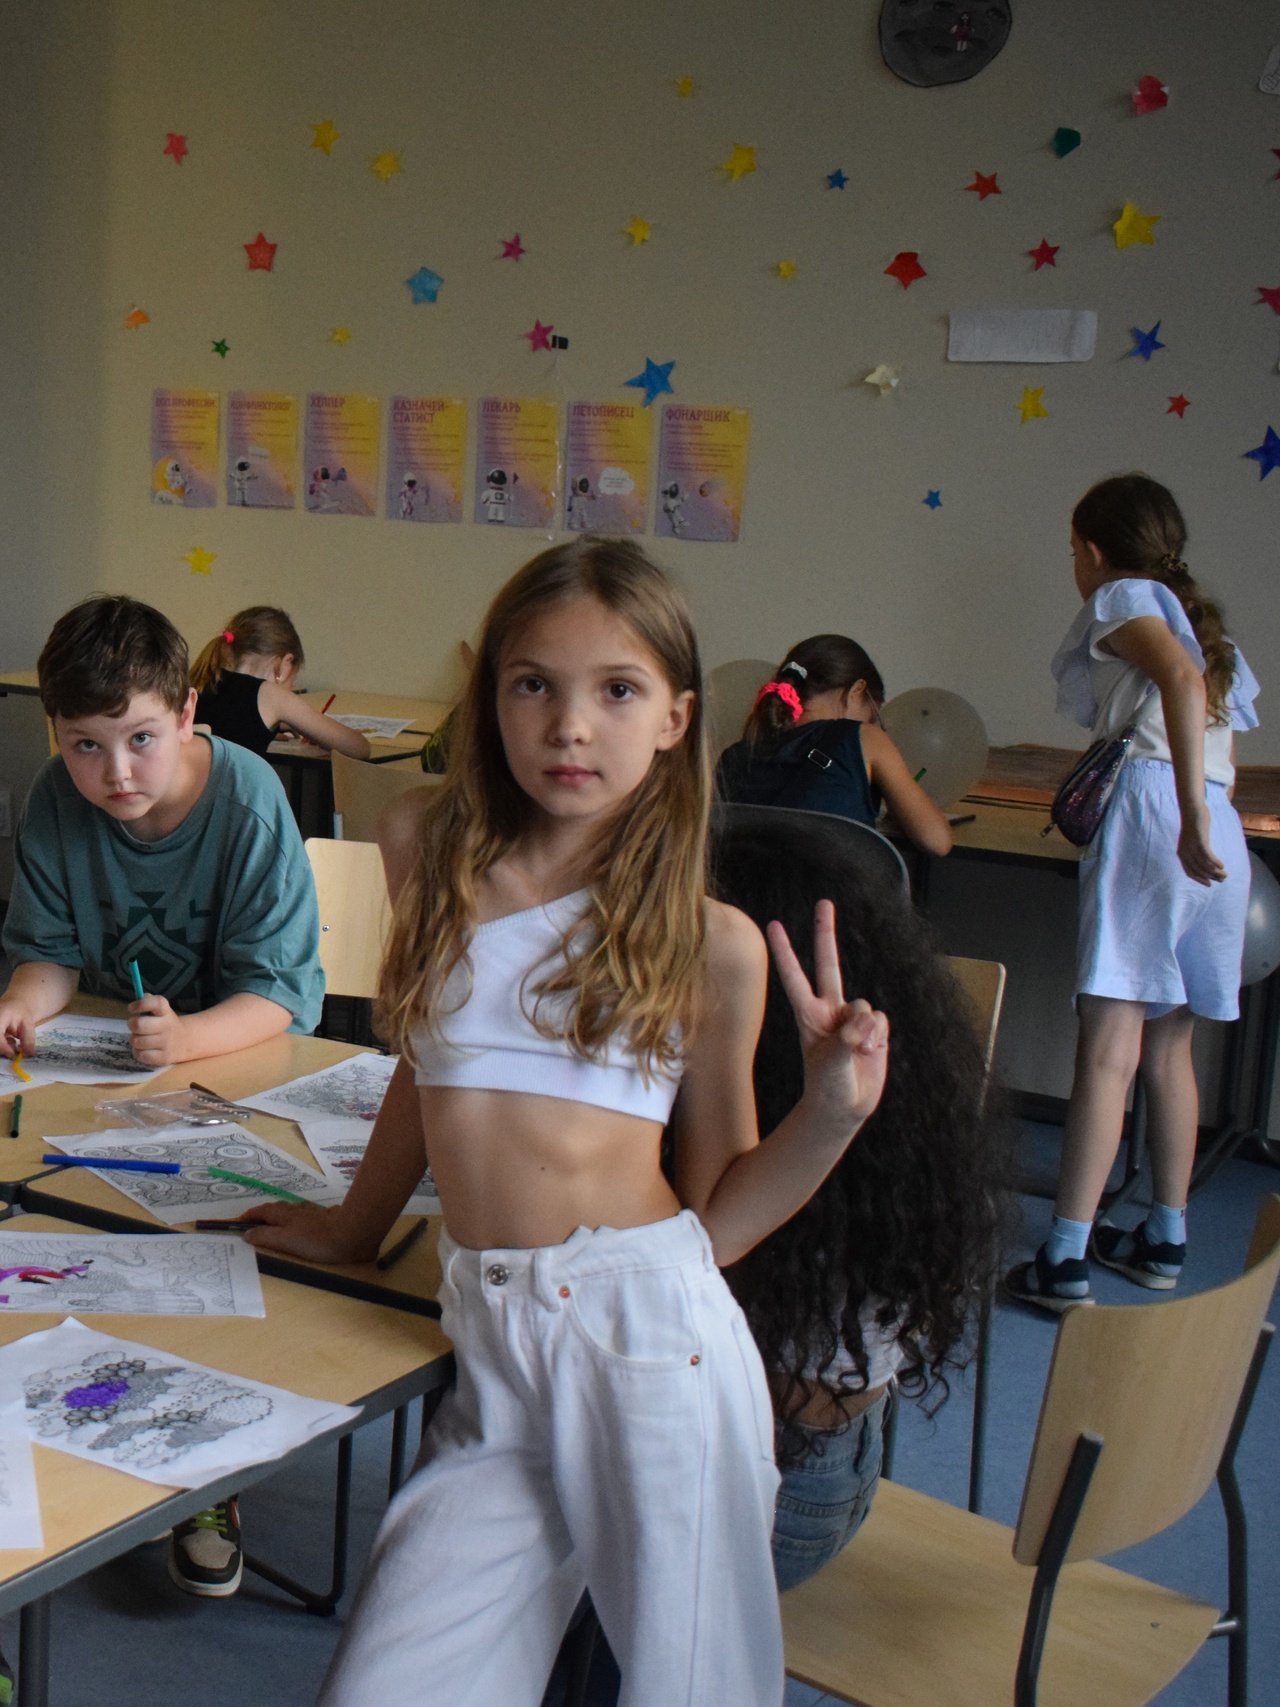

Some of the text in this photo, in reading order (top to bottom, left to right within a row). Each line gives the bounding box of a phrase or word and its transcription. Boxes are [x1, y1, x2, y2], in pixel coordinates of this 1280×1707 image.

[482, 401, 521, 413] ЛЕКАРЬ
[572, 404, 634, 418] ЛЕТОПИСЕЦ
[665, 408, 731, 422] ФОНАРЩИК
